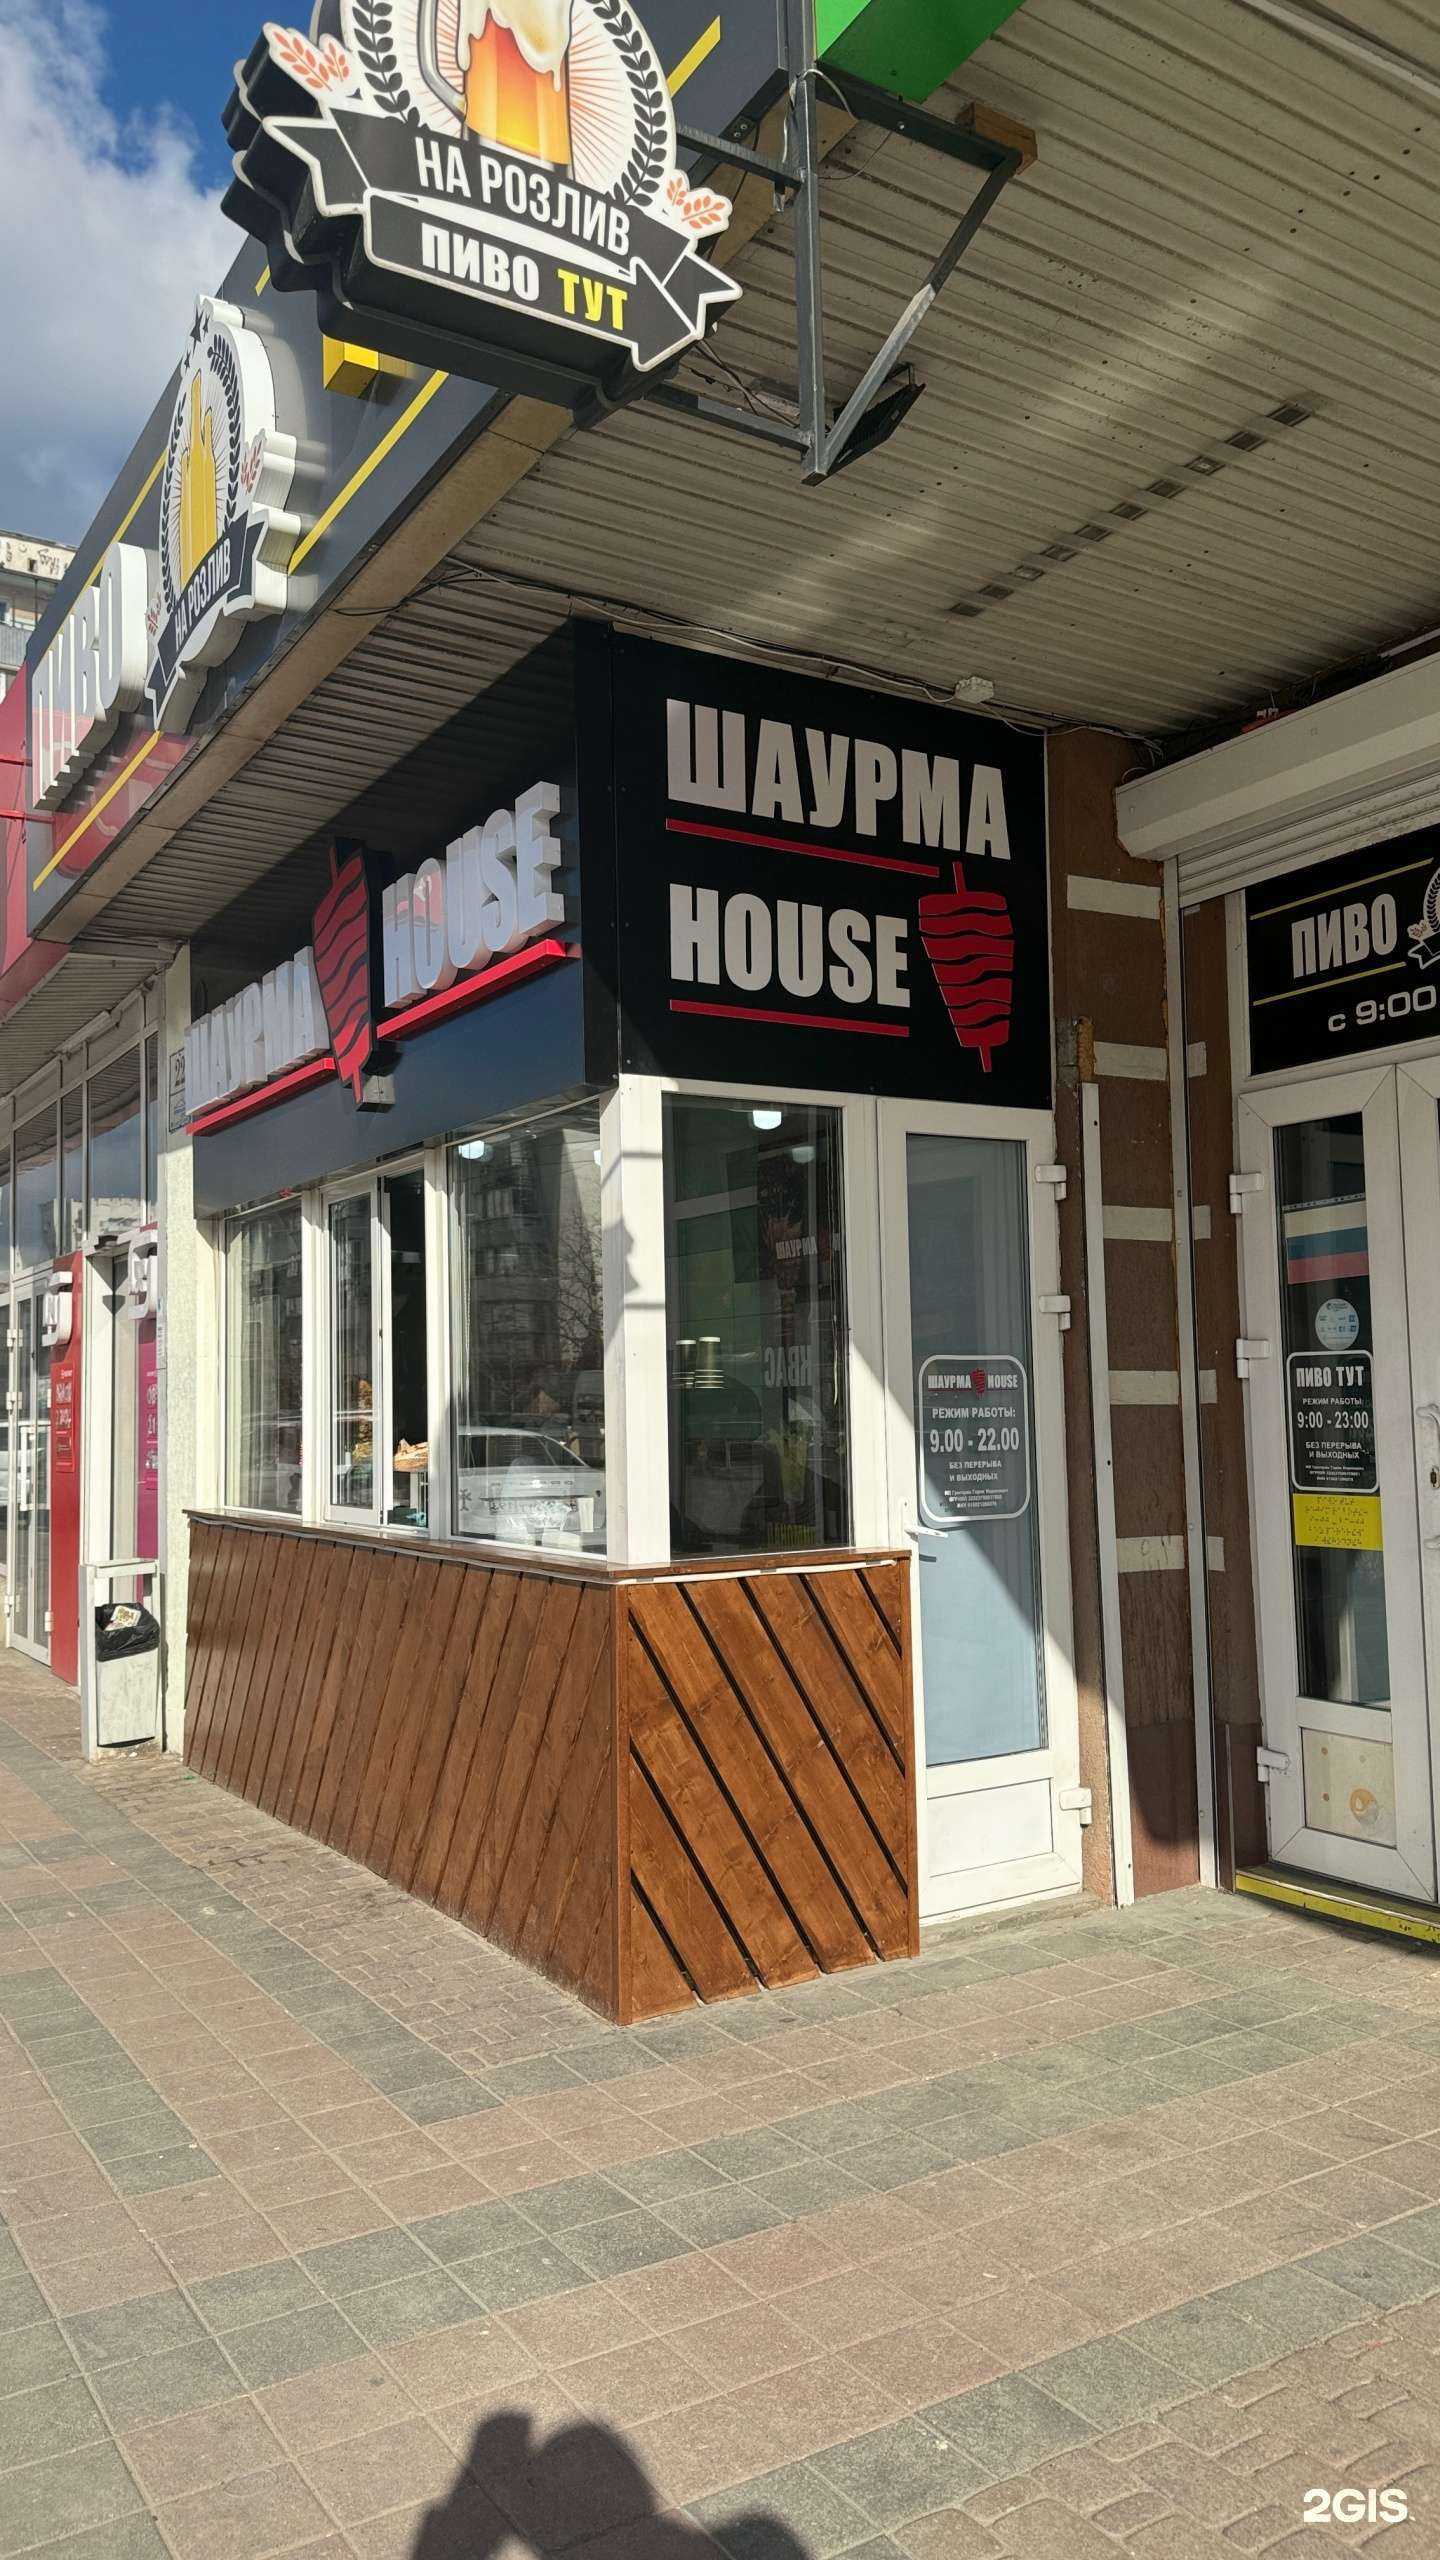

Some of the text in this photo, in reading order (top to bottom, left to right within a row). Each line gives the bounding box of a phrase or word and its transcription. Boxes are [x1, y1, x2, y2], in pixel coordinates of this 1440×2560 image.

[415, 136, 630, 256] НА РОЗЛИВ
[421, 222, 628, 331] ПИВО ТУТ
[175, 538, 231, 651] НА РОЗЛИВ
[32, 543, 135, 807] ПИВО
[666, 698, 1011, 860] ШАУРМА
[184, 782, 563, 1116] ШАУРМА HOUSE
[669, 883, 911, 1008] HOUSE
[1291, 893, 1398, 980] ПИВО
[1355, 985, 1438, 1025] 9:00
[928, 1374, 1018, 1388] ШАУРМА HOUSE
[1296, 1366, 1365, 1388] ПИВО ТУТ
[932, 1406, 1016, 1419] РЕЖИМ РАБОТЫ:
[1302, 1397, 1329, 1405] РЕЖИМ
[1297, 1411, 1323, 1428] 9:00
[1334, 1411, 1369, 1428] 23:00
[929, 1428, 963, 1453] 9.00
[977, 1427, 1019, 1451] 22.00
[1305, 1441, 1362, 1450] БЕЗ ПЕРЕРЫВА
[949, 1460, 1002, 1470] БЕЗ ПЕРЕРЫВА
[1309, 1450, 1360, 1460] И ВЫХОДНЫХ
[956, 1472, 998, 1482] ВЫХОДНЫХ
